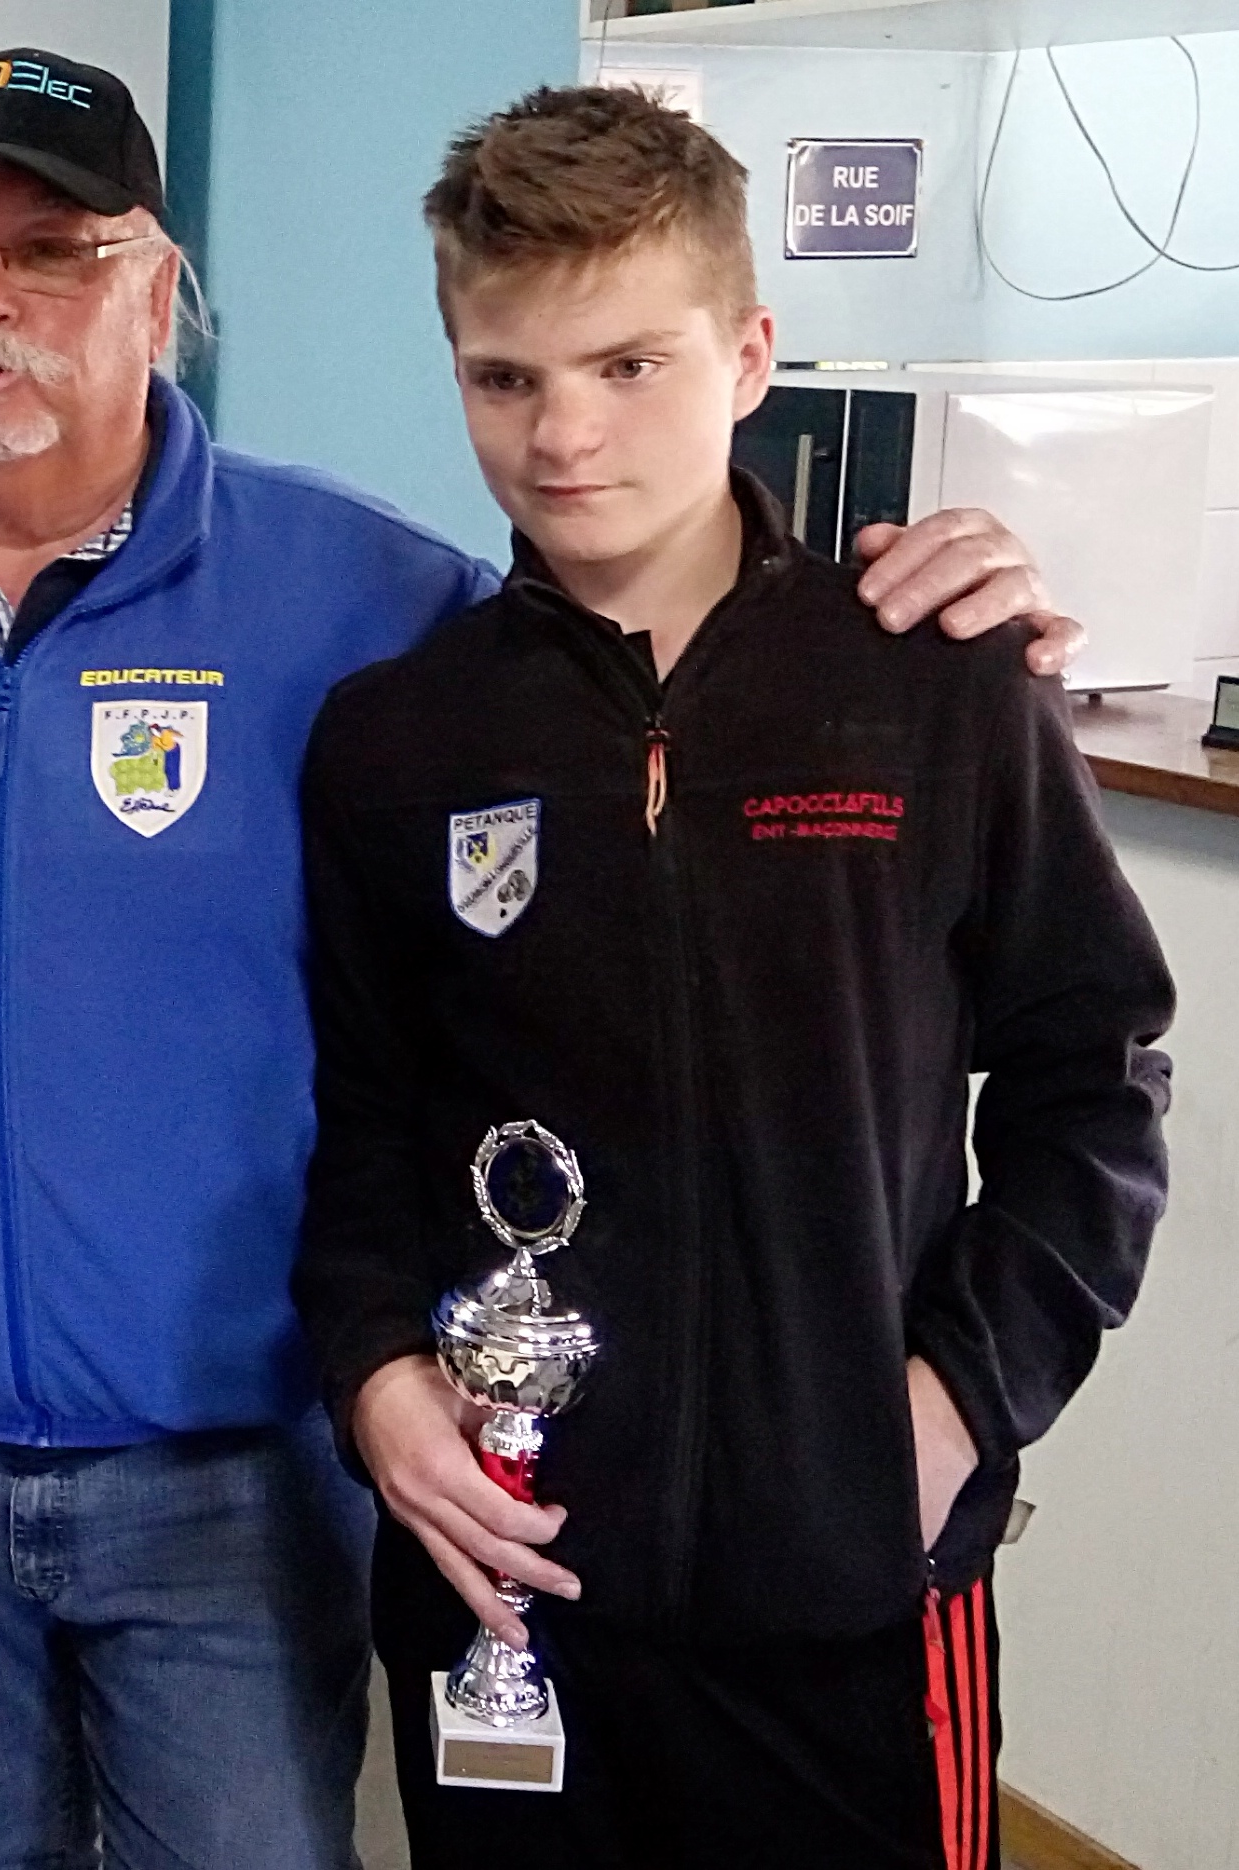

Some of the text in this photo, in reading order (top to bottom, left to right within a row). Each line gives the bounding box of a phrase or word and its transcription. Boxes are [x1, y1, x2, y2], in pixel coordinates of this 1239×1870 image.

[832, 165, 880, 188] RUE
[794, 204, 915, 226] DE LA SOIF
[79, 668, 225, 687] EDUCATEUR
[453, 803, 538, 831] PETANQUE
